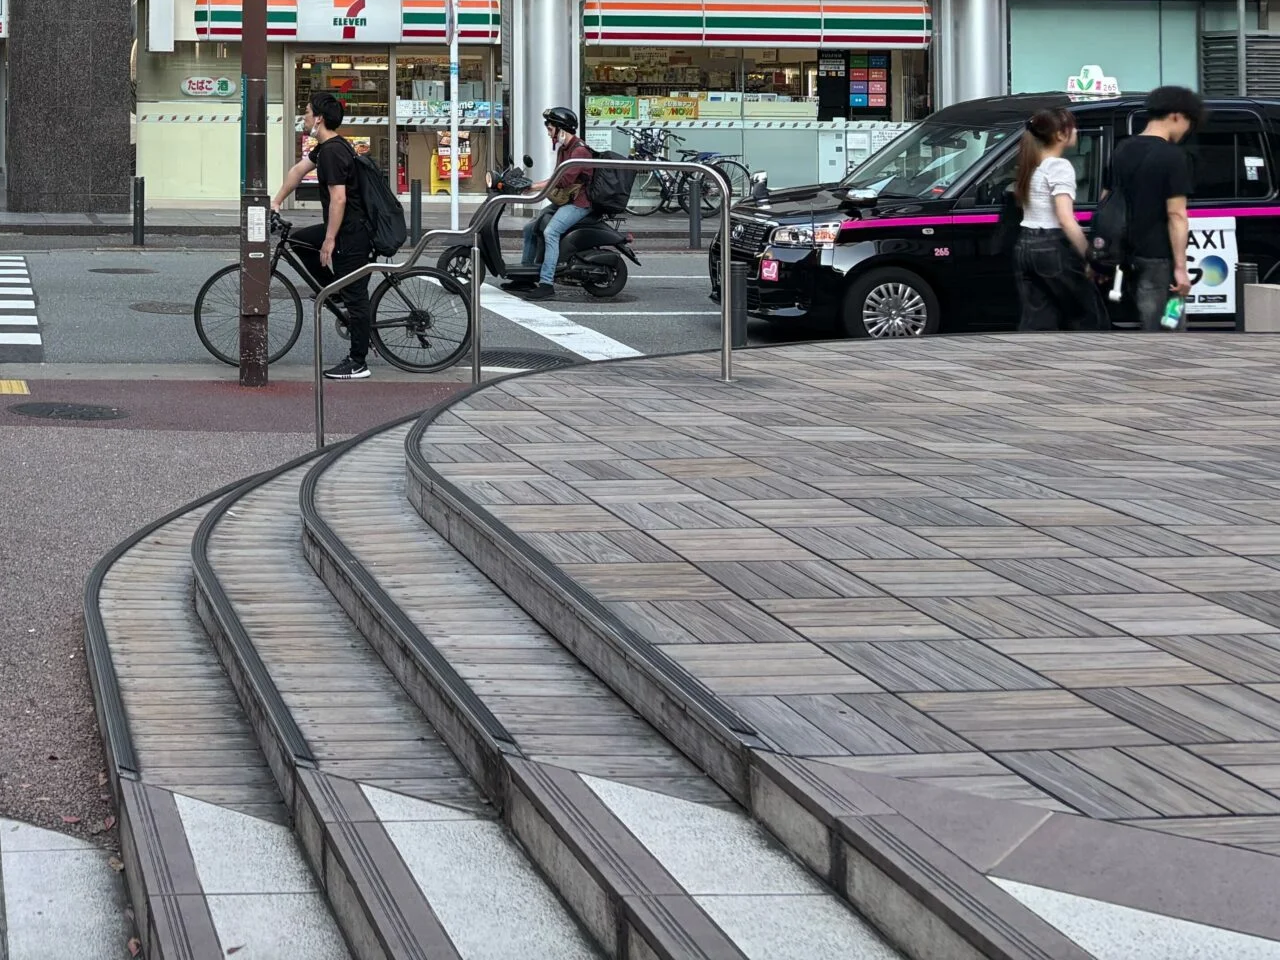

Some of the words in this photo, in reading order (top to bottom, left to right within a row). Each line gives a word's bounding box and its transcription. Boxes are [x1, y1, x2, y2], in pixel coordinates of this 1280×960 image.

[188, 80, 213, 91] たばこ
[1186, 230, 1225, 249] AXI
[934, 247, 950, 256] 265
